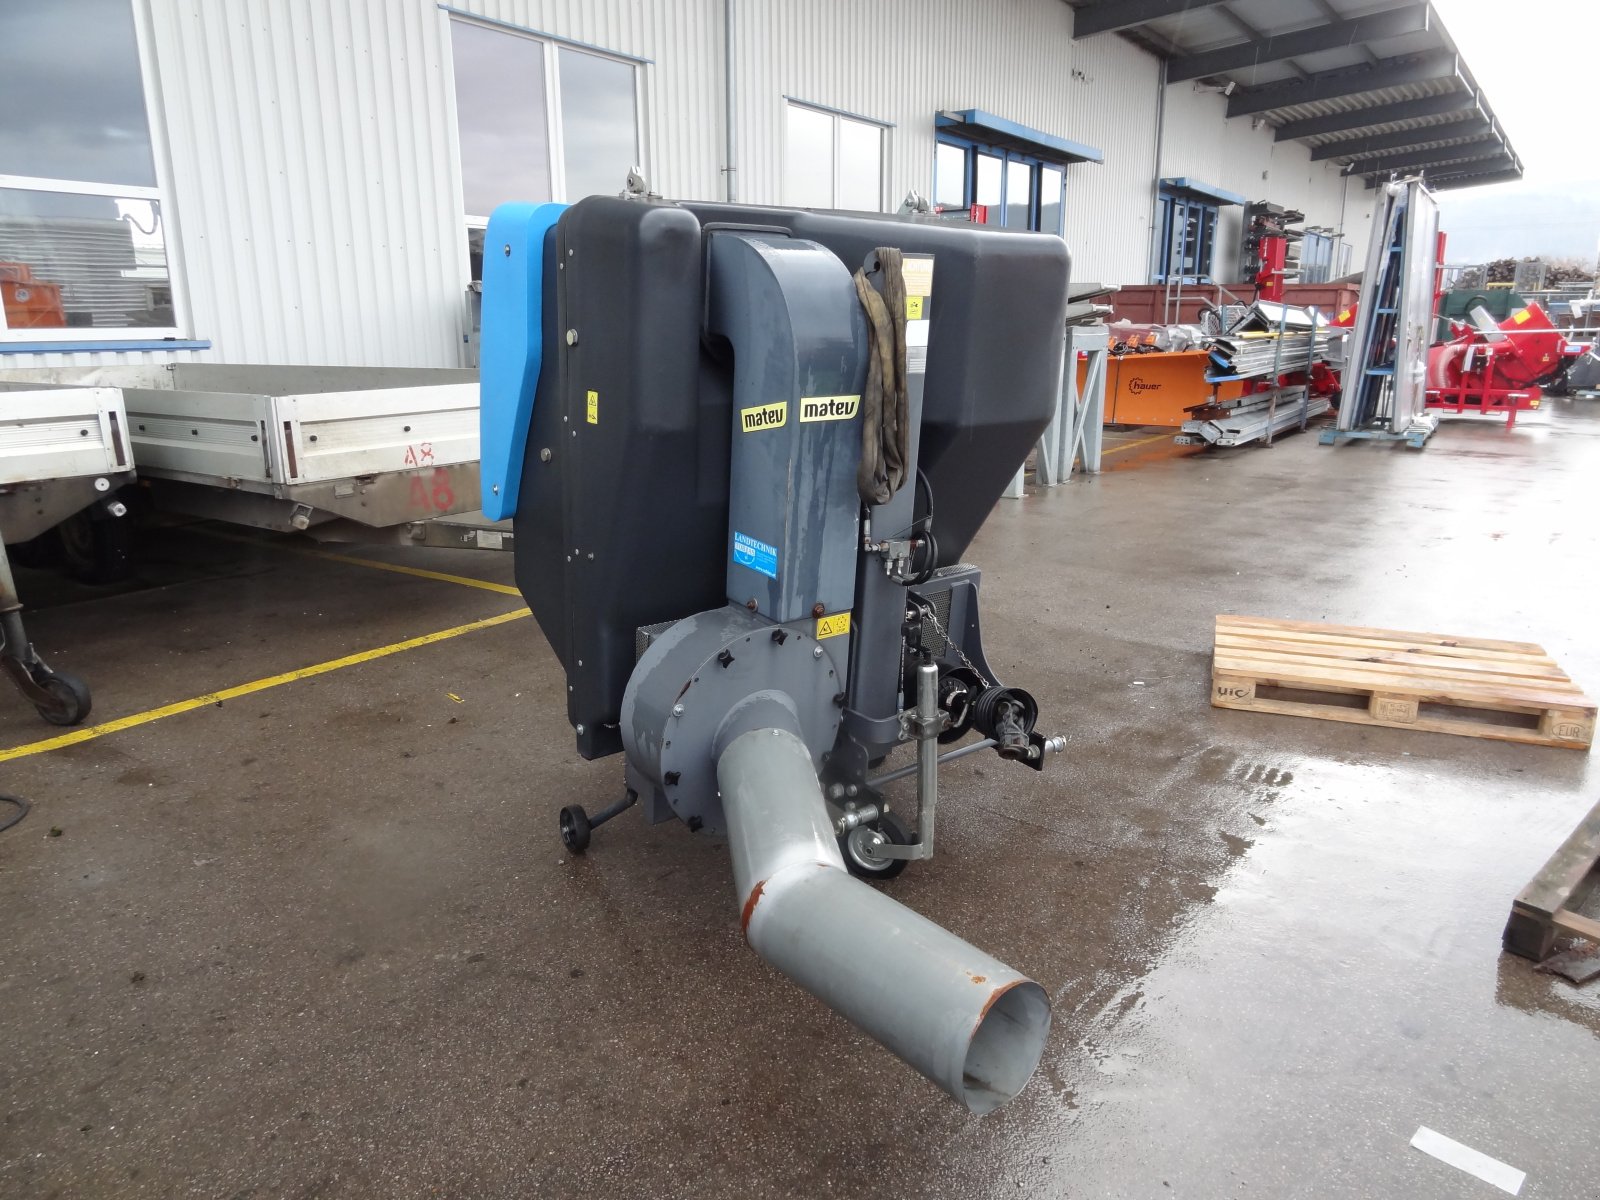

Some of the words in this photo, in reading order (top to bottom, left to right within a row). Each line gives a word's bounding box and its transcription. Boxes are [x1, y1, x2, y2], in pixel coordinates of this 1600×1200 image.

[1133, 381, 1162, 390] hauer
[744, 407, 784, 428] matev
[804, 399, 855, 418] matev
[404, 442, 434, 467] A8
[406, 467, 455, 511] A8
[735, 531, 777, 557] LANDTECHNIK
[1559, 725, 1580, 737] EUR
